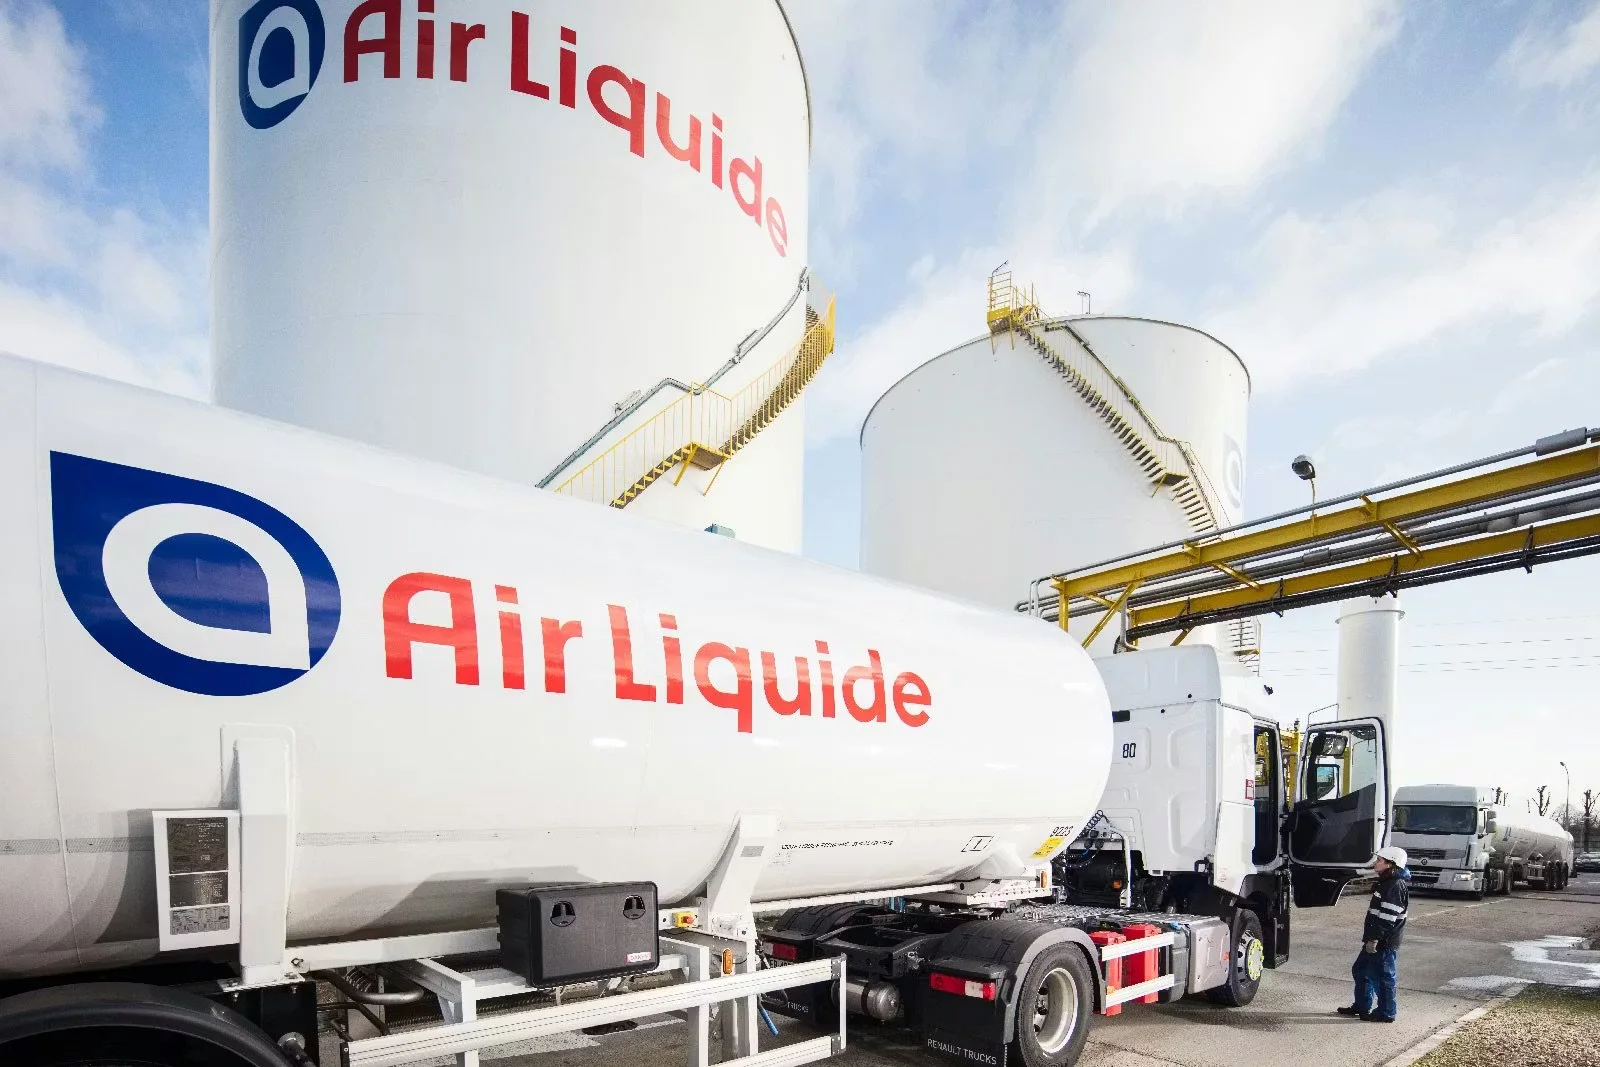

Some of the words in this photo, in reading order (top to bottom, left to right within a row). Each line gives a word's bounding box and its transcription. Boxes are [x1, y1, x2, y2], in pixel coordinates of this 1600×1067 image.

[343, 0, 485, 83] Air
[510, 11, 788, 258] Liquide
[382, 571, 583, 694] Air
[606, 604, 932, 733] Liquide
[1122, 743, 1137, 759] 80
[1050, 825, 1074, 837] 9223
[927, 1038, 962, 1055] RENAULT
[963, 1048, 997, 1065] TRUCKS
